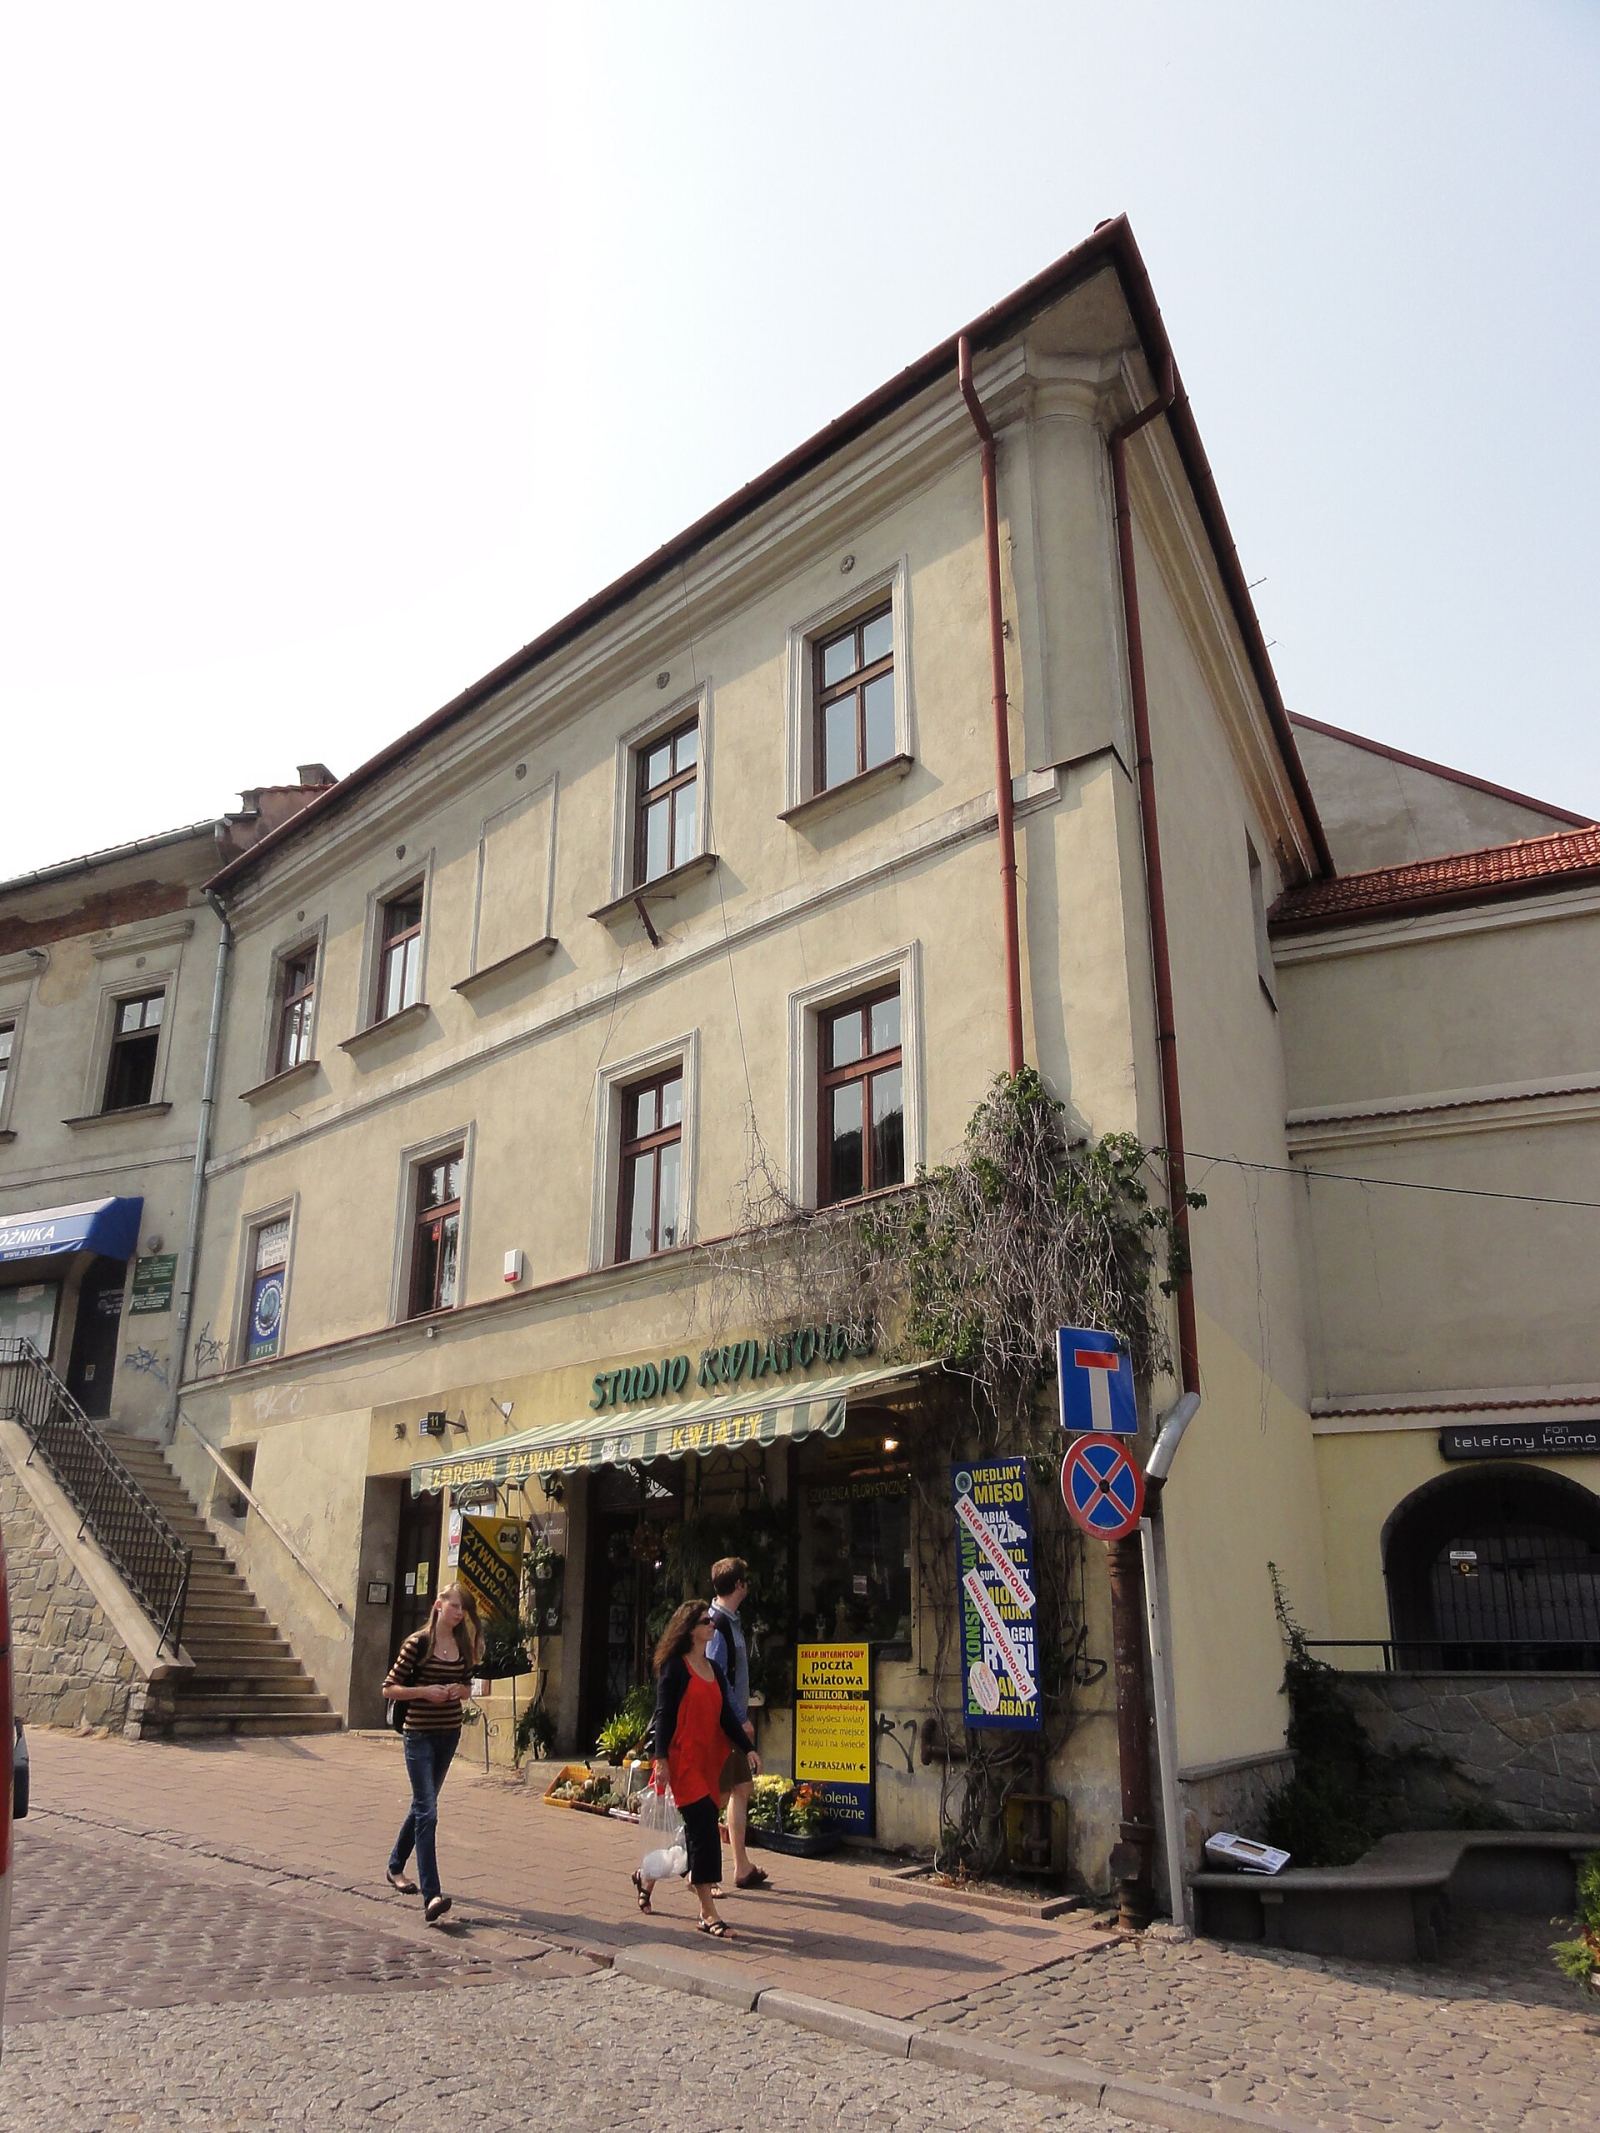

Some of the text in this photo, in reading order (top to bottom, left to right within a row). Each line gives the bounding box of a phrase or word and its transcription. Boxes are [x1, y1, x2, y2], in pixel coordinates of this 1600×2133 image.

[590, 1355, 690, 1410] STUDIO
[672, 1412, 762, 1449] KWIATY
[1454, 1435, 1535, 1448] telefony
[432, 1458, 495, 1487] ZDROWA
[972, 1465, 1021, 1484] WĘDLINY
[974, 1482, 1024, 1507] MIĘSO
[961, 1502, 1031, 1604] SKLEP INTERNETOWY
[968, 1576, 1031, 1696] www.kuzdrowotnosci.pl
[801, 1650, 864, 1659] SKLEP INTERNETOWY
[811, 1660, 853, 1673] poczta
[802, 1673, 863, 1685] kwiatowa
[803, 1690, 849, 1699] INTERFLORA
[839, 1727, 865, 1737] miejsce
[808, 1738, 823, 1749] kraju
[808, 1761, 857, 1771] ZAPRASZAMY
[823, 1808, 866, 1820] styczne
